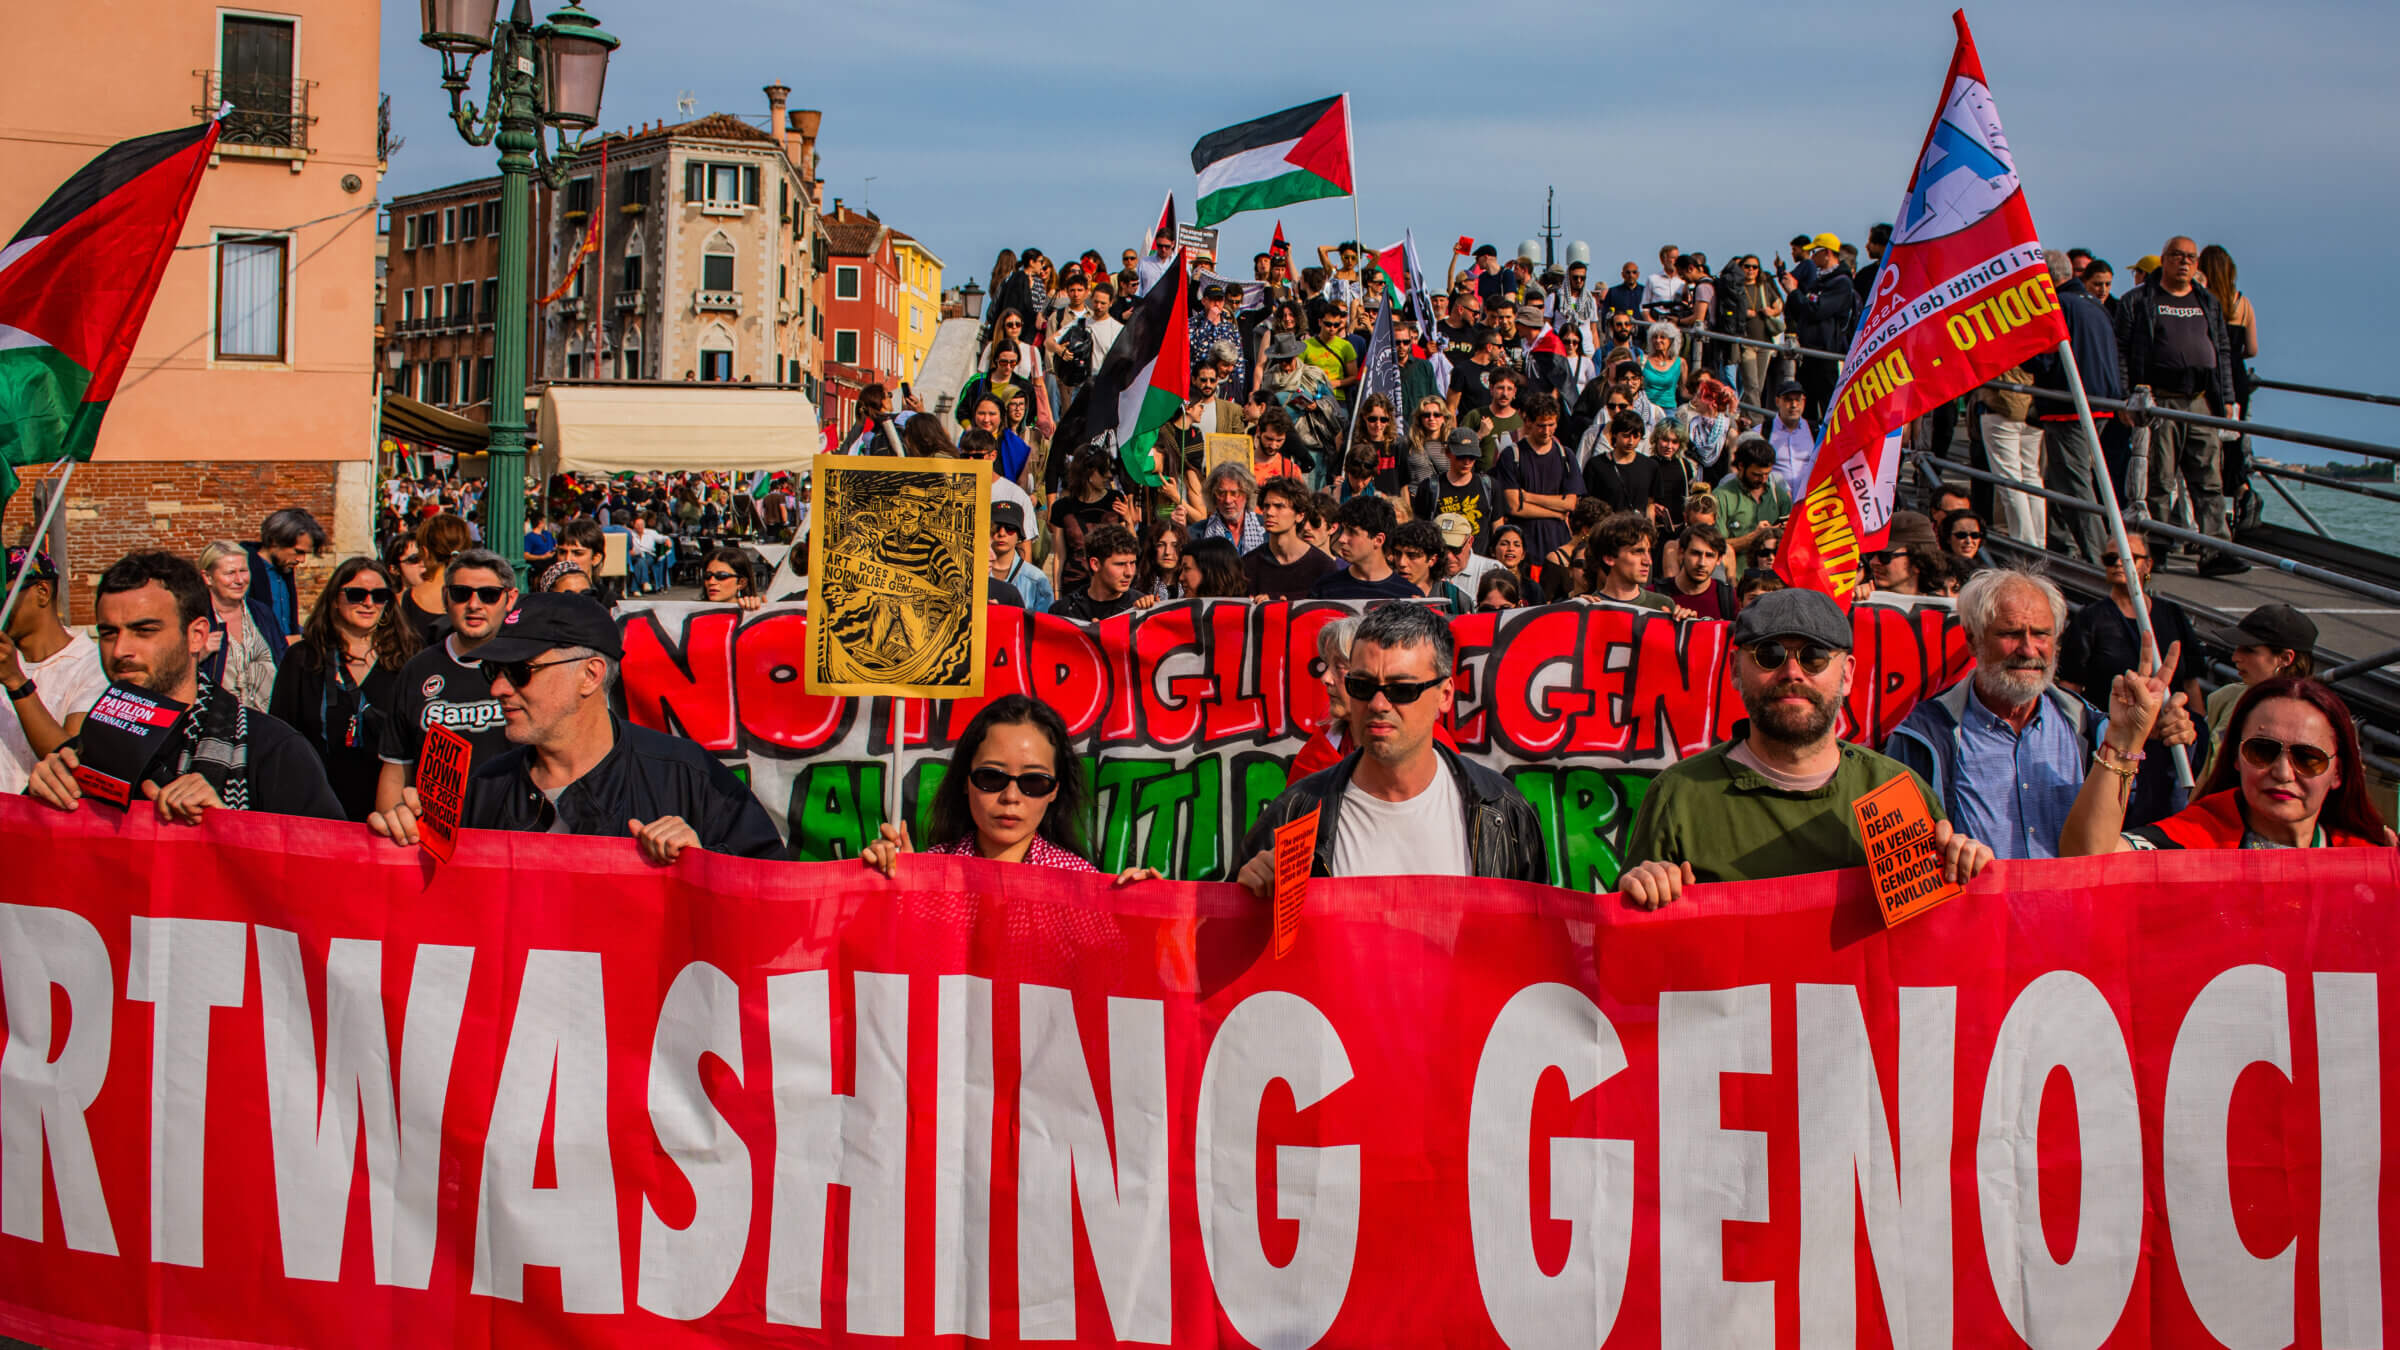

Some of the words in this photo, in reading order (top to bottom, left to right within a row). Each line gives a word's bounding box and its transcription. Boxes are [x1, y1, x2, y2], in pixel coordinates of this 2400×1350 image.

[824, 566, 886, 589] NORMALISE
[826, 552, 851, 568] ART
[859, 561, 888, 578] DOES
[894, 572, 912, 585] NOT
[107, 687, 121, 696] NO
[121, 691, 158, 708] GENOCIDE
[616, 602, 859, 760] NO
[102, 695, 155, 721] PAVILION
[127, 723, 150, 737] 2026
[429, 731, 462, 768] SHUT
[420, 777, 435, 796] THE
[424, 753, 462, 793] DOWN
[1861, 801, 1879, 821] NO
[1866, 807, 1904, 839] DEATH
[1871, 840, 1885, 858] IN
[1886, 818, 1928, 849] VENICE
[1876, 858, 1894, 877] NO
[1895, 847, 1911, 865] TO
[1914, 836, 1937, 857] THE
[1881, 854, 1943, 894] GENOCIDE
[1886, 874, 1943, 912] PAVILION
